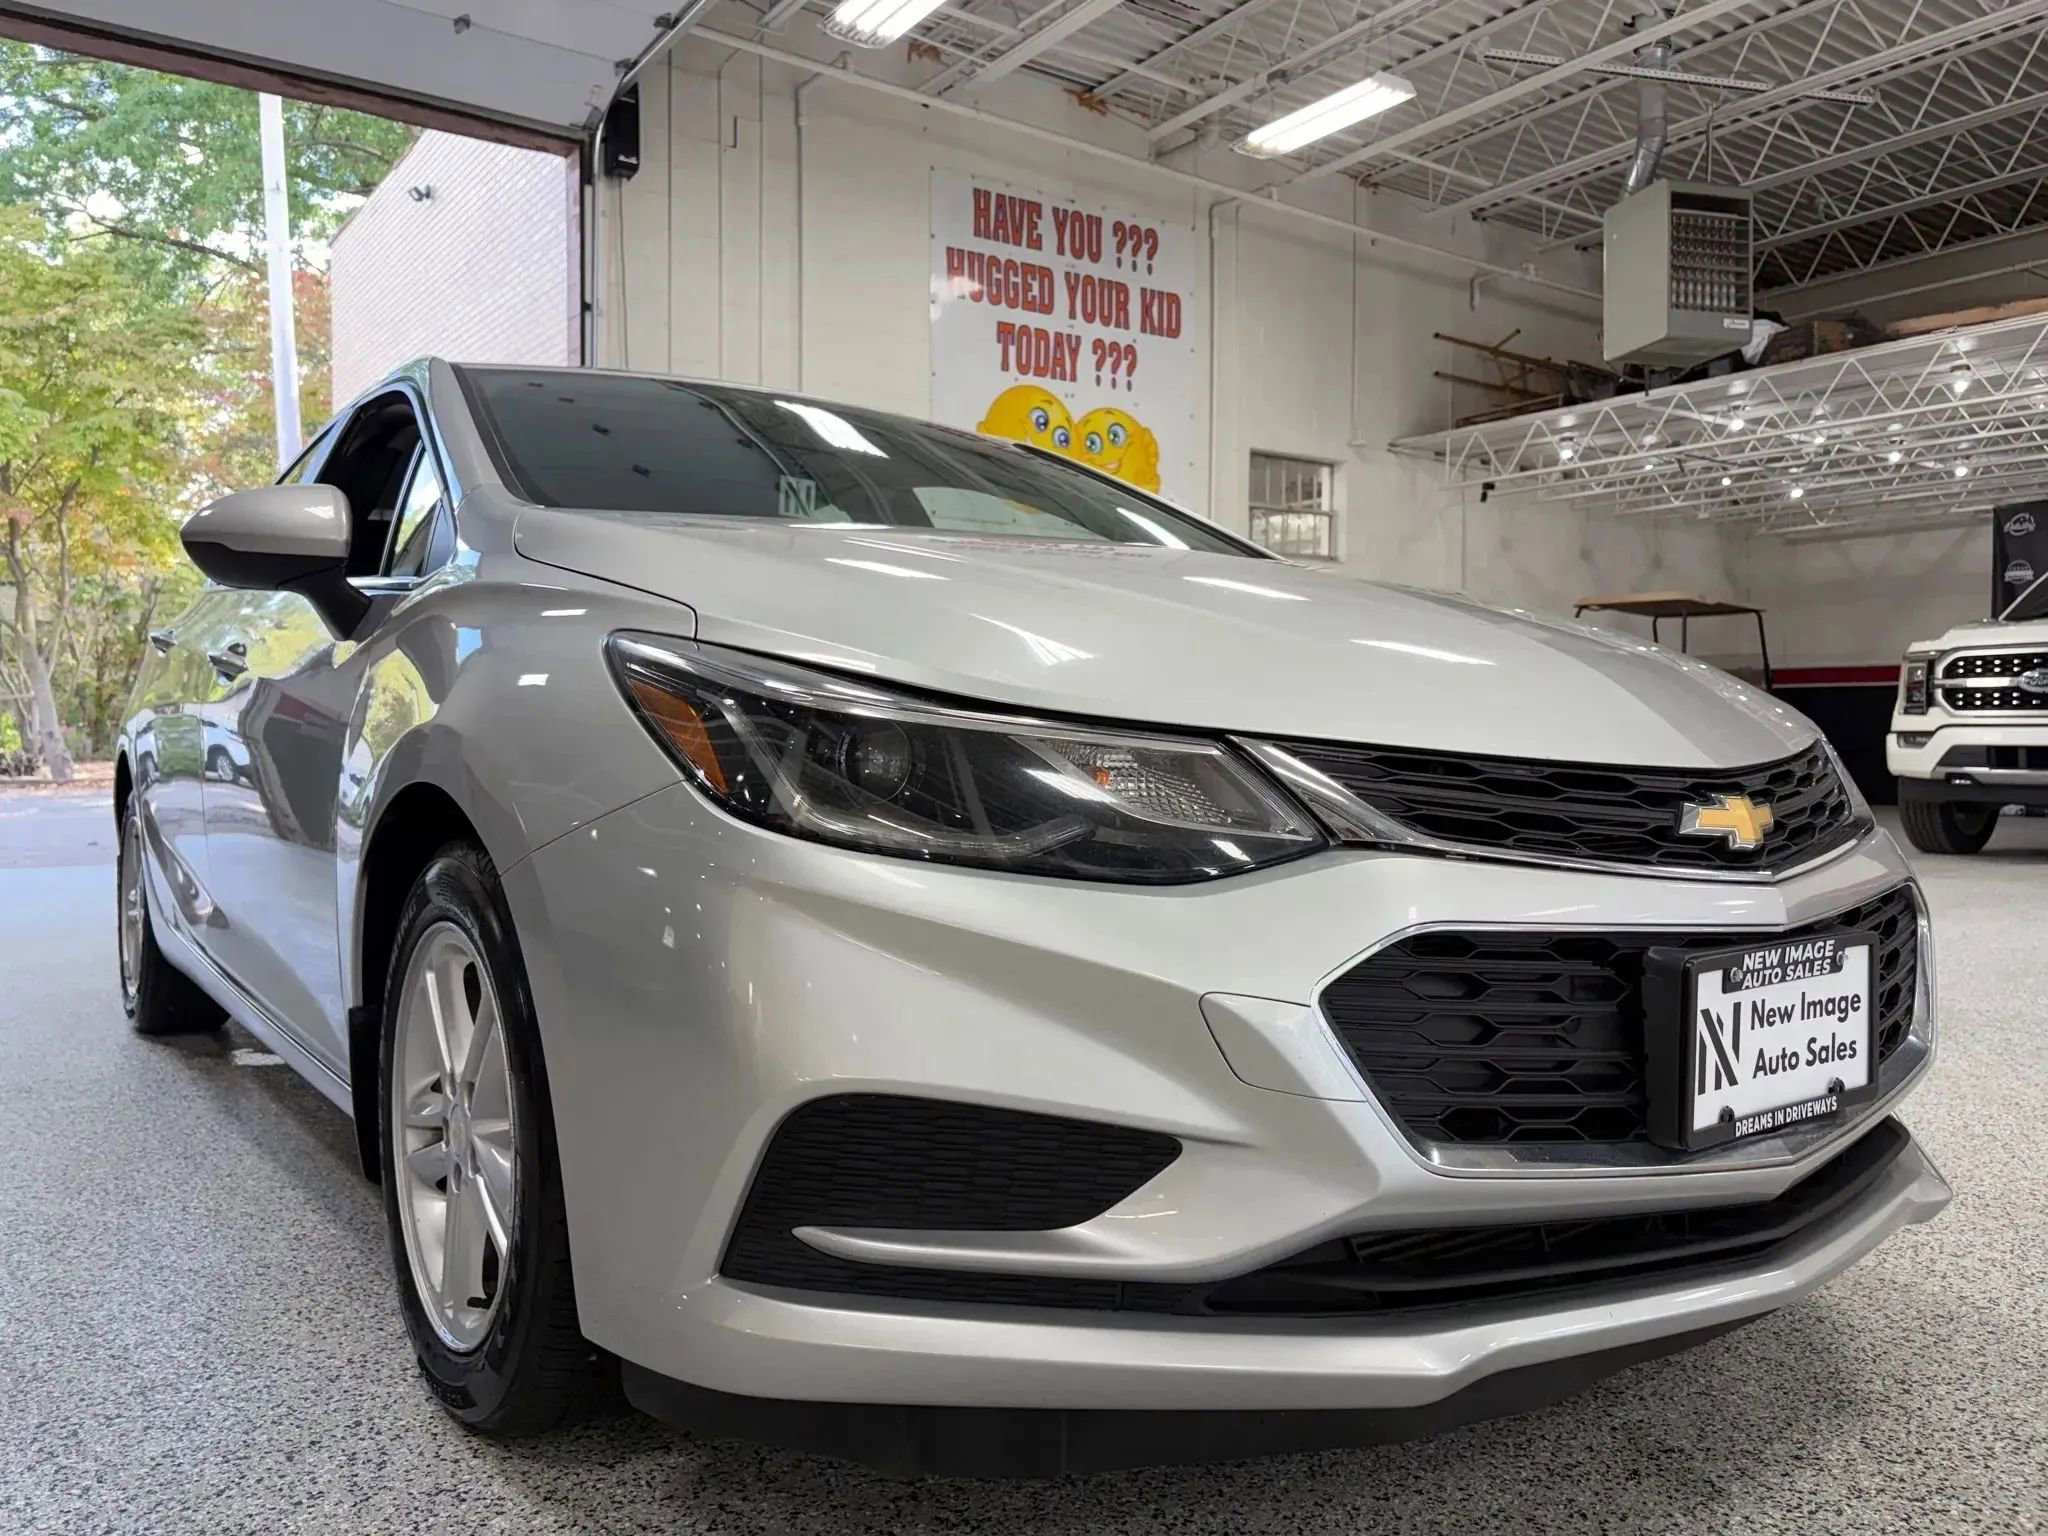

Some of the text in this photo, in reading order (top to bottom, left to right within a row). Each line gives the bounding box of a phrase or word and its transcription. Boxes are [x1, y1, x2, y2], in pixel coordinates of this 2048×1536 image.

[972, 187, 1159, 276] HAVE YOU ???
[945, 246, 1182, 339] HUGGED YOUR KID
[996, 320, 1138, 392] TODAY ???
[1741, 959, 1831, 990] AUTO SALES
[1742, 939, 1835, 972] NEW IMAGE
[1750, 991, 1861, 1031] New Image
[1752, 1032, 1857, 1079] Auto Sales
[1735, 1095, 1837, 1137] DREAMS IN DRIVEWAYS
